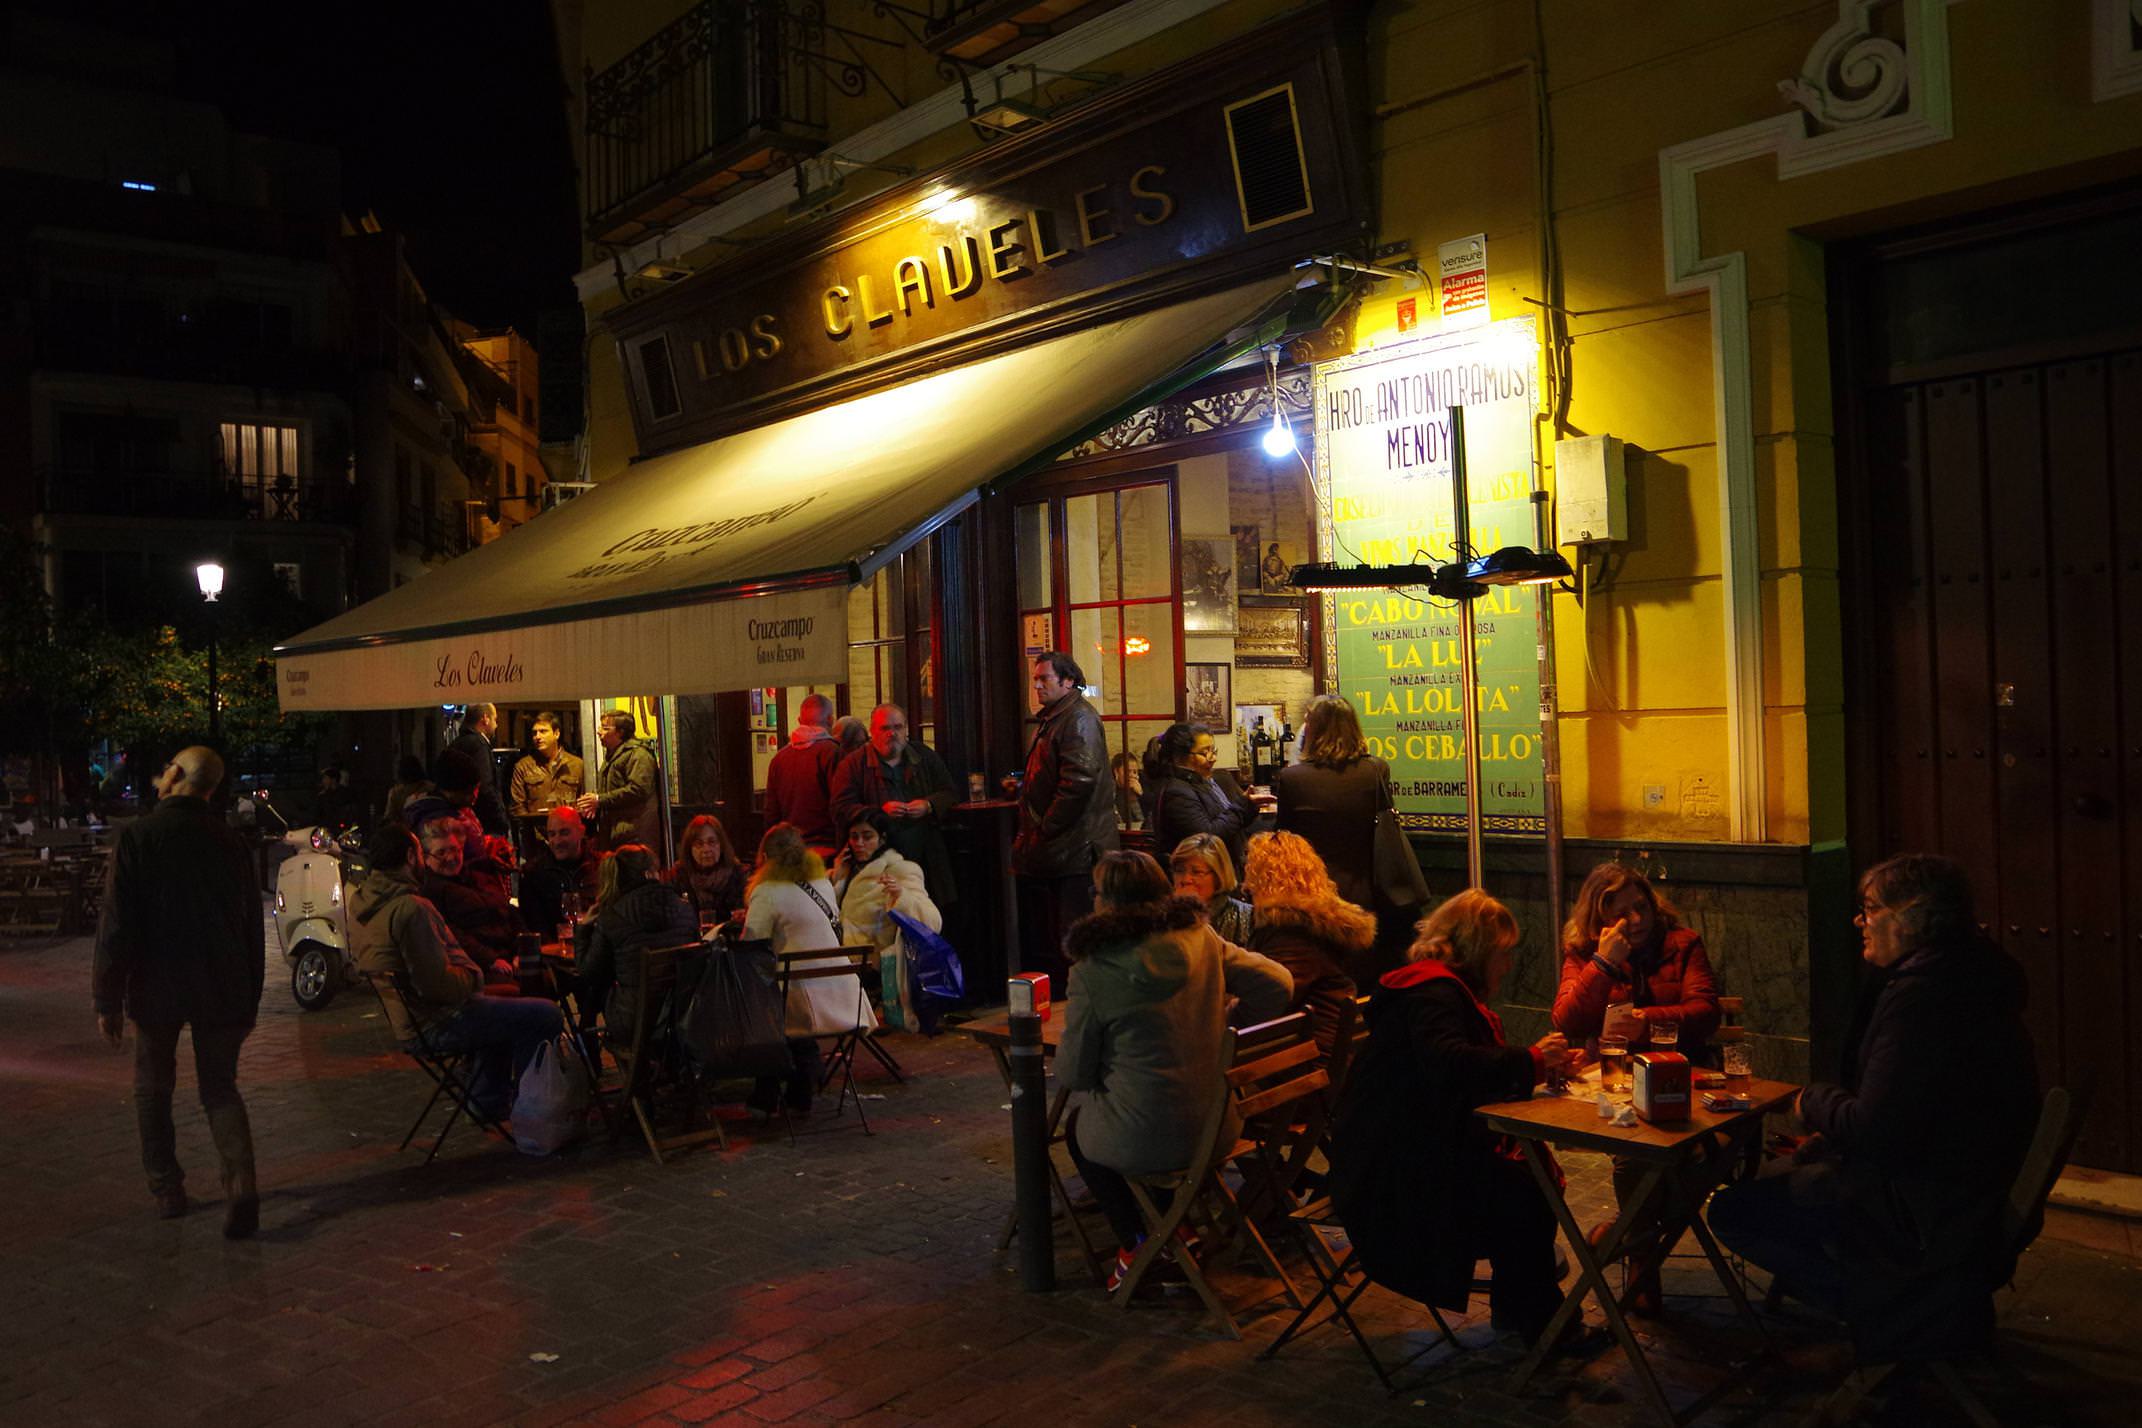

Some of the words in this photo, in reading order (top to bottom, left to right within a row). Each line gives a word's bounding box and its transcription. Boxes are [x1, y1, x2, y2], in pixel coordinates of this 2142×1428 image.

[691, 313, 784, 381] LOS
[821, 165, 1178, 339] CLAVELES
[1443, 274, 1485, 290] Alarma
[1377, 367, 1454, 422] ANTONIO
[1457, 361, 1526, 407] RAMOS
[748, 616, 814, 641] Cruzcampo
[1372, 626, 1428, 641] MANZANILLA
[1430, 624, 1451, 638] FINA
[1454, 623, 1496, 636] OOSA
[433, 653, 462, 688] Los
[467, 650, 523, 686] Claveles
[1390, 673, 1446, 687] MANZANILLA
[1407, 685, 1521, 714] LOLTA"
[1396, 720, 1453, 733] MANZANILLA
[1414, 782, 1467, 797] BARRAME
